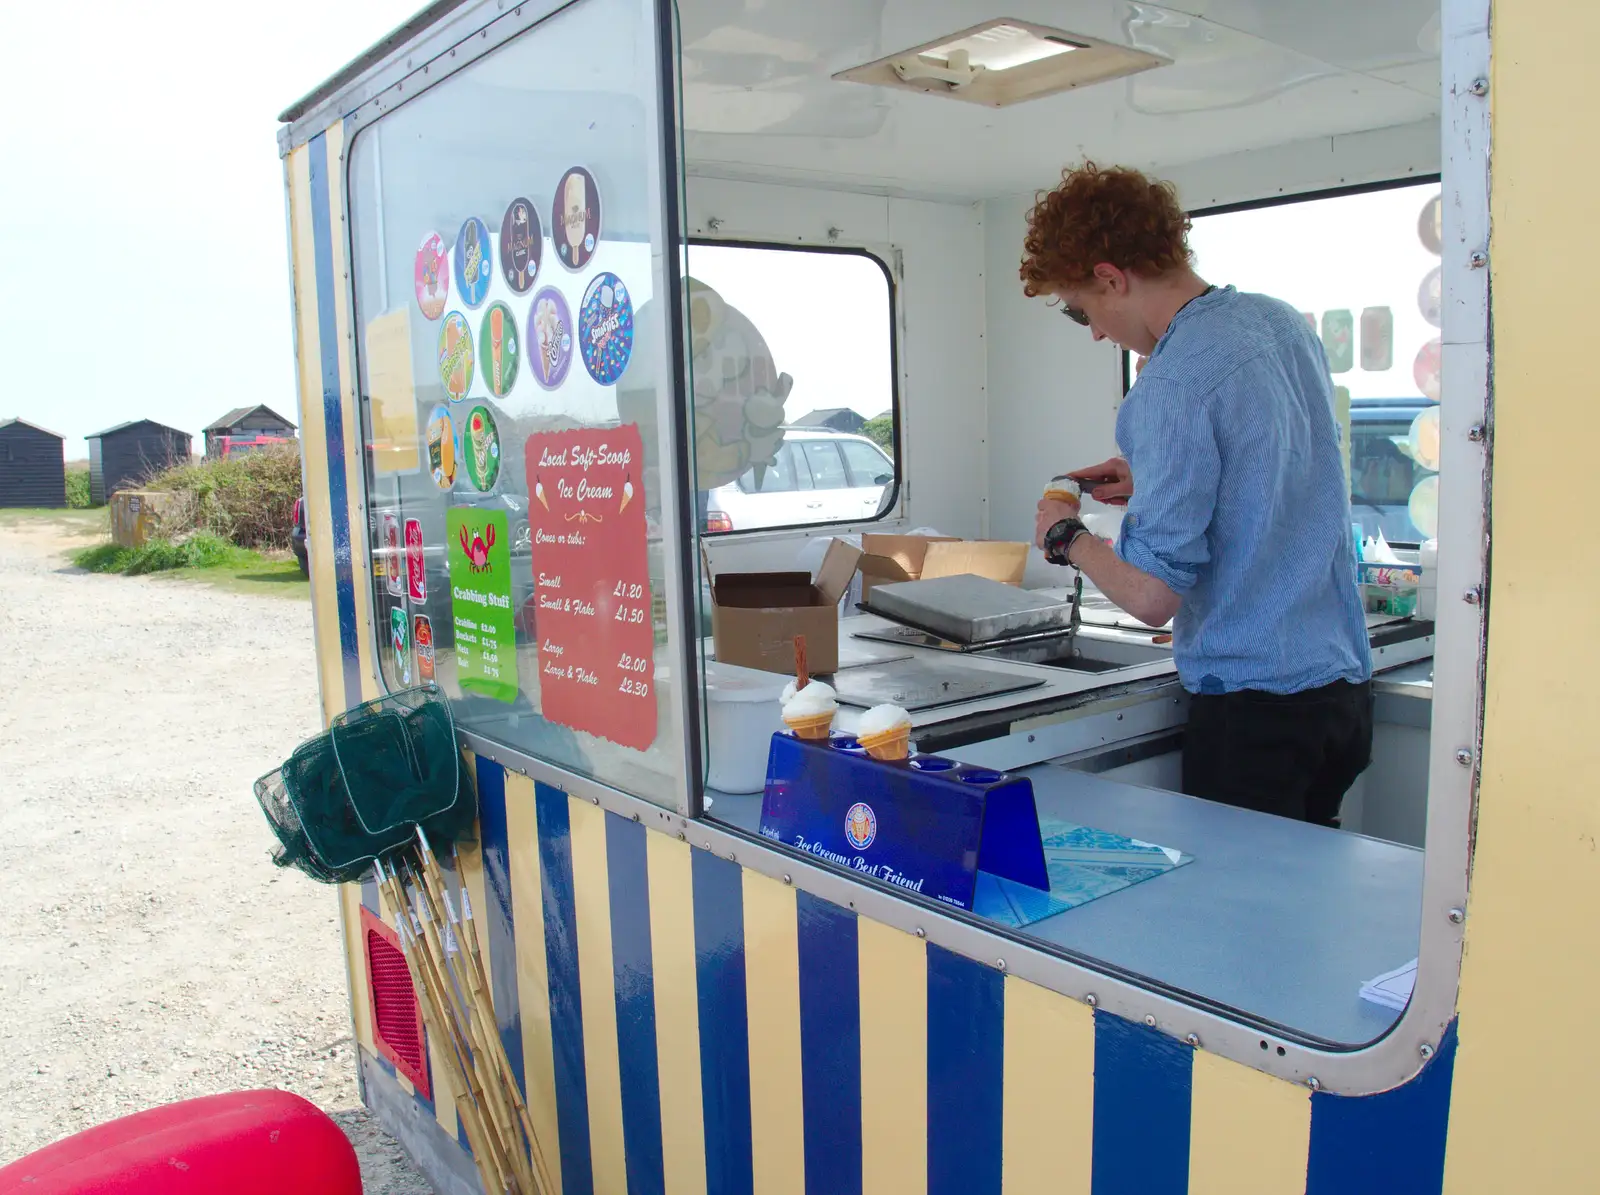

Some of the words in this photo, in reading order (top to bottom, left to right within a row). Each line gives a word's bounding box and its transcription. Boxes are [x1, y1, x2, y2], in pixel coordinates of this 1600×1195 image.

[538, 446, 567, 467] Local
[570, 443, 631, 471] Soft-Scoop
[557, 478, 574, 498] Ice
[576, 478, 613, 502] Cream
[535, 528, 556, 544] Cones
[558, 534, 566, 544] or
[567, 530, 586, 545] tubs:
[453, 586, 488, 607] Crabbing
[487, 592, 510, 608] Stuff
[538, 572, 561, 588] Small
[613, 579, 643, 599] £1.20
[540, 594, 562, 610] Small
[564, 598, 571, 612] &
[572, 599, 595, 616] Flake
[614, 604, 644, 624] £1.50
[542, 638, 564, 658] Large
[617, 652, 647, 673] £2.00
[544, 660, 565, 680] Large
[567, 665, 573, 679] &
[575, 667, 598, 685] Flake
[619, 676, 648, 697] £2.30
[794, 834, 811, 852] Ice
[812, 841, 851, 867] Creams
[852, 855, 879, 877] Best
[878, 865, 924, 893] Friend
